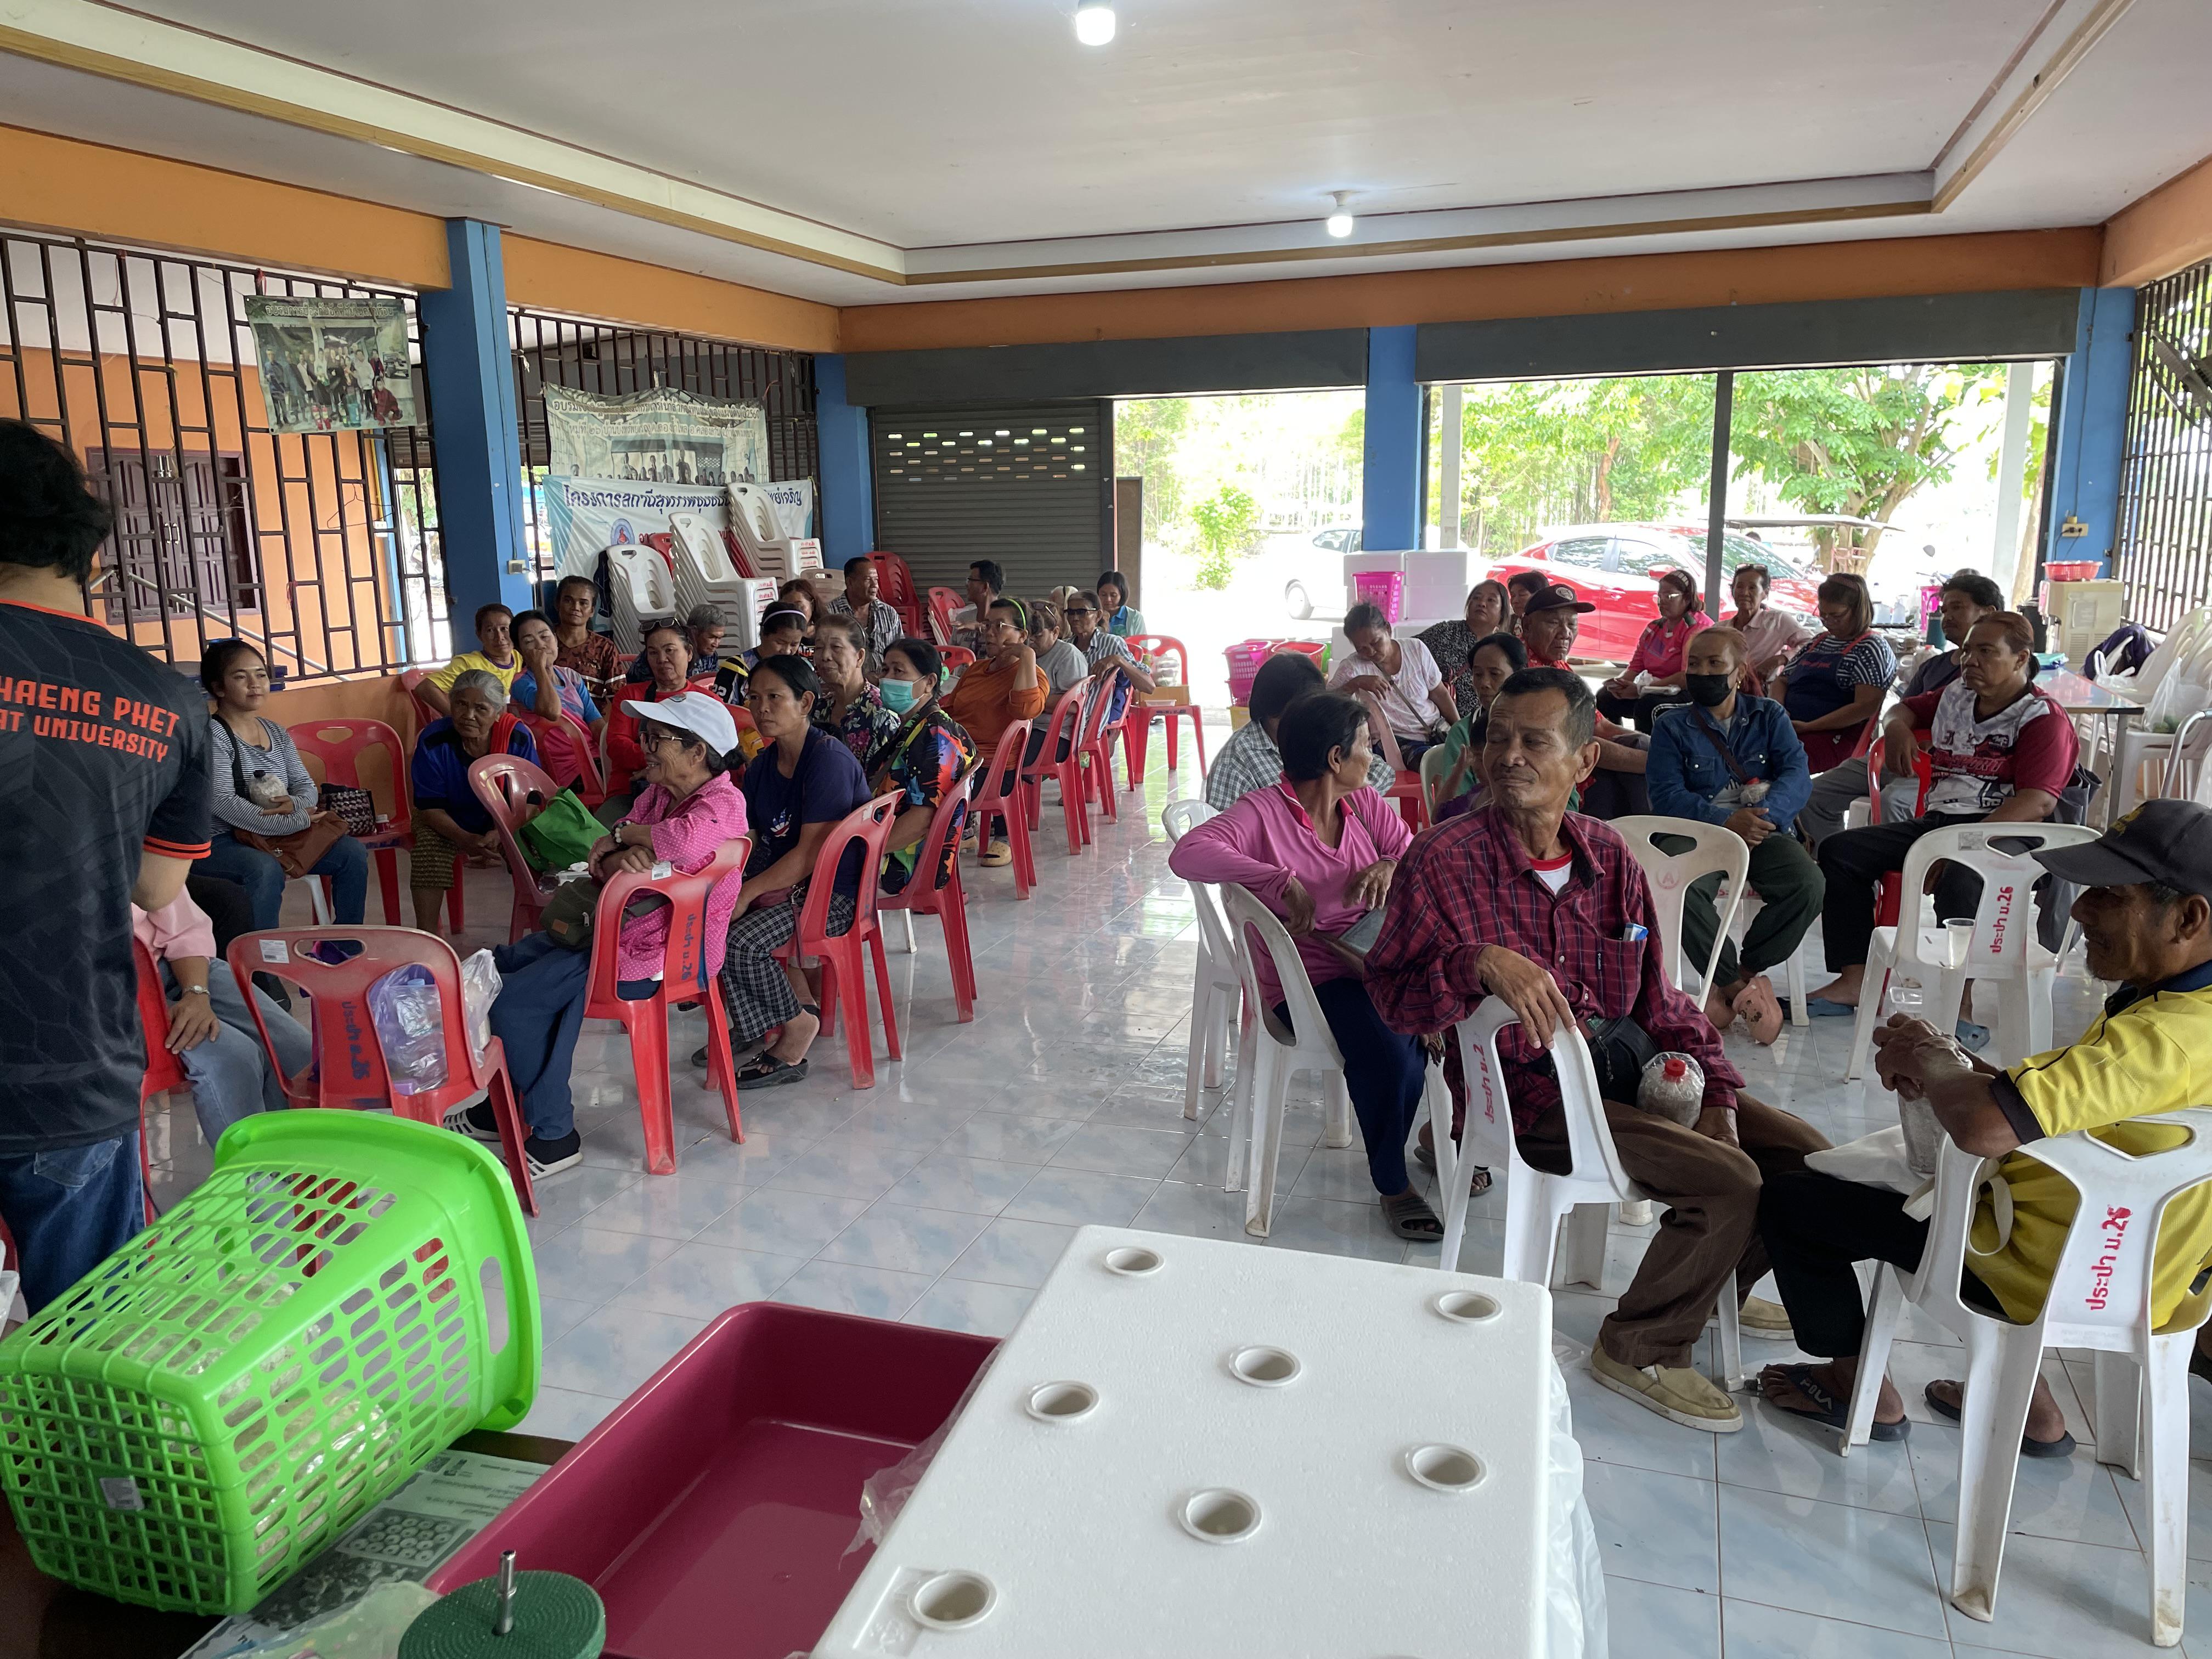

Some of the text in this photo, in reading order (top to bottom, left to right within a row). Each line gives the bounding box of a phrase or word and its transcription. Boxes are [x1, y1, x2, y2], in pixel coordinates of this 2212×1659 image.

[34, 715, 168, 762] UNIVERSITY
[114, 697, 179, 737] PHET
[1990, 886, 2013, 953] ประปา ม.26
[1481, 1077, 1494, 1124] ประปา
[2085, 1255, 2117, 1310] ประปา
